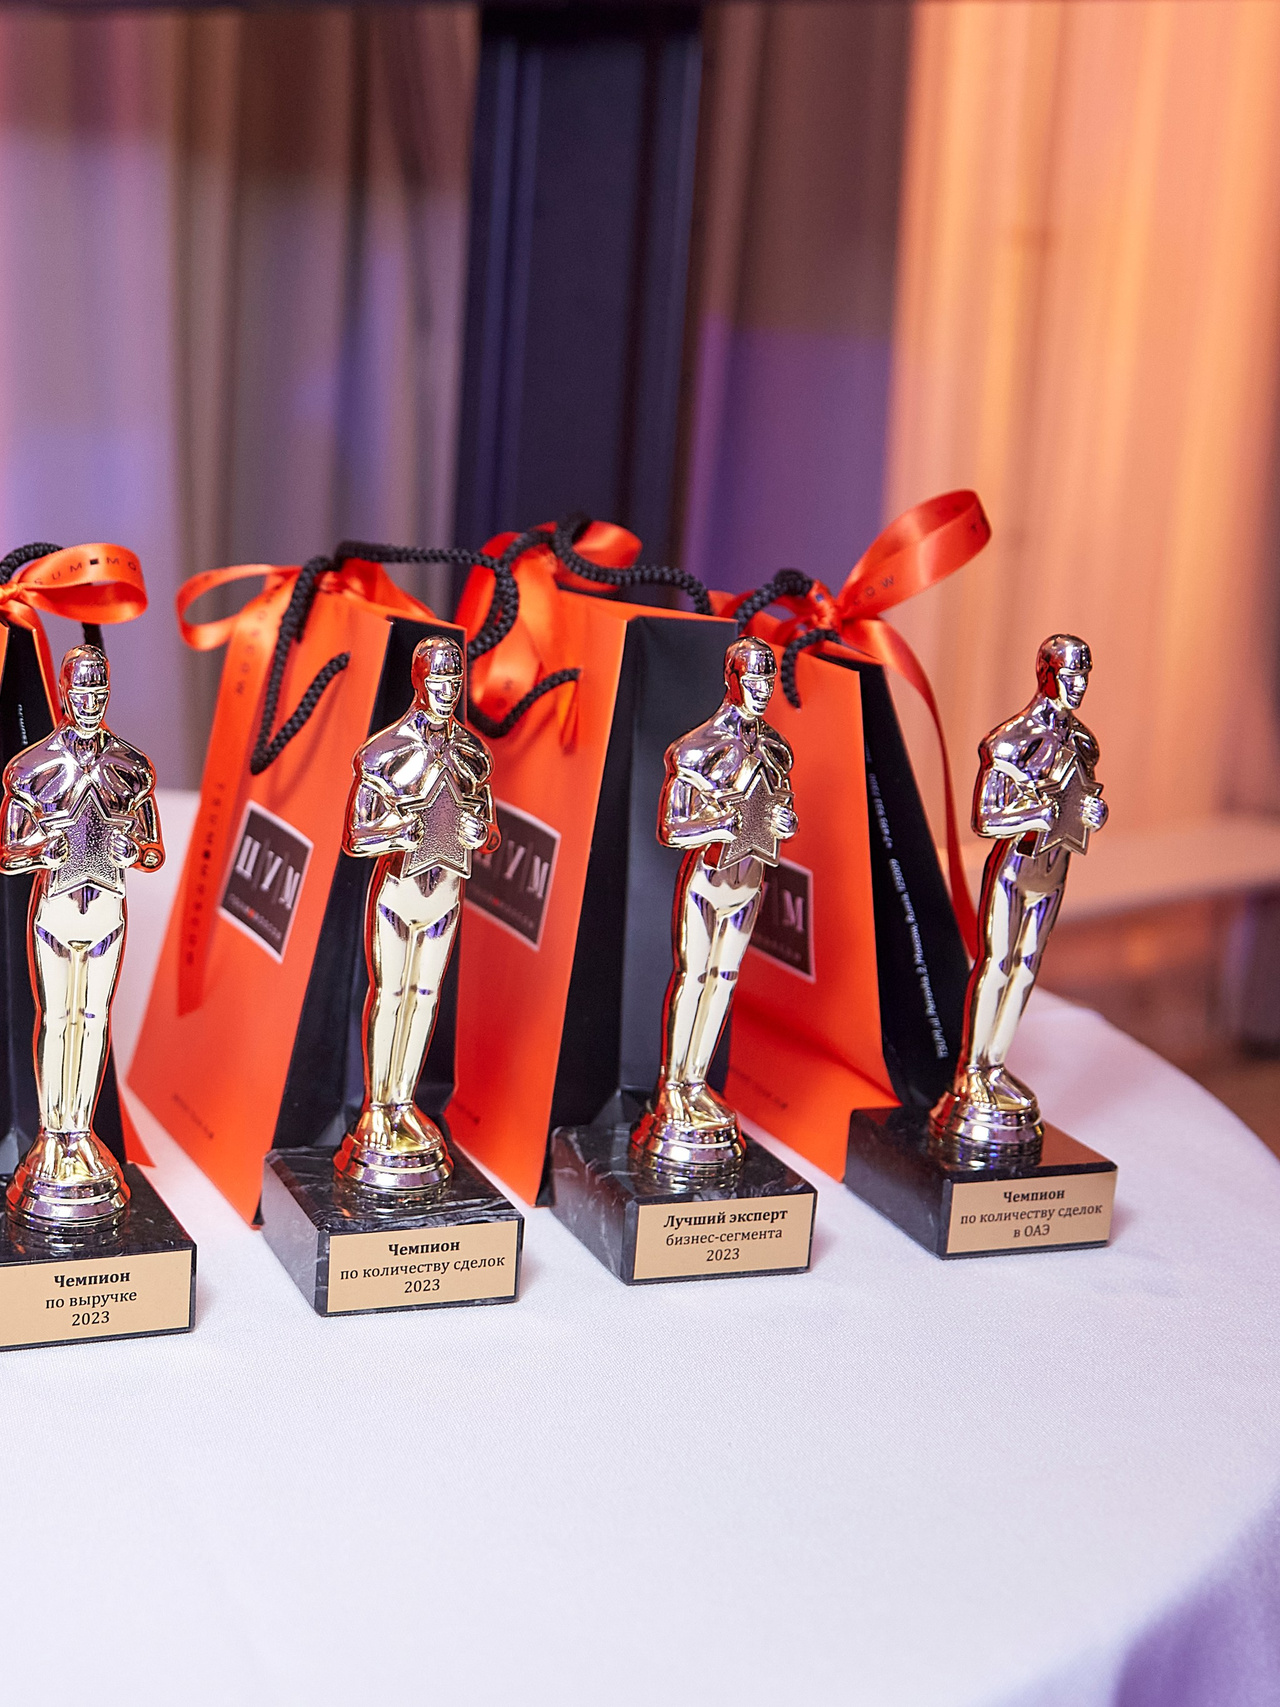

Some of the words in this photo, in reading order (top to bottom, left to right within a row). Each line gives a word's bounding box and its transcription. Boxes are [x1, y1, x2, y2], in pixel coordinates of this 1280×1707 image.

[1003, 1189, 1065, 1203] Чемпион
[663, 1212, 726, 1230] Лучший
[729, 1210, 789, 1224] эксперт
[960, 1214, 977, 1225] по
[979, 1208, 1056, 1223] количеству
[1057, 1204, 1103, 1218] сделок
[665, 1228, 783, 1246] бизнес-сегмента
[1013, 1229, 1021, 1238] в
[1024, 1224, 1051, 1238] ОАЭ
[388, 1241, 461, 1257] Чемпион
[706, 1247, 740, 1262] 2023
[340, 1269, 359, 1280] по
[362, 1261, 451, 1278] количеству
[453, 1256, 506, 1272] сделок
[53, 1272, 131, 1288] Чемпион
[404, 1278, 441, 1294] 2023
[45, 1298, 65, 1309] по
[69, 1291, 137, 1308] выручке
[71, 1310, 111, 1327] 2023
